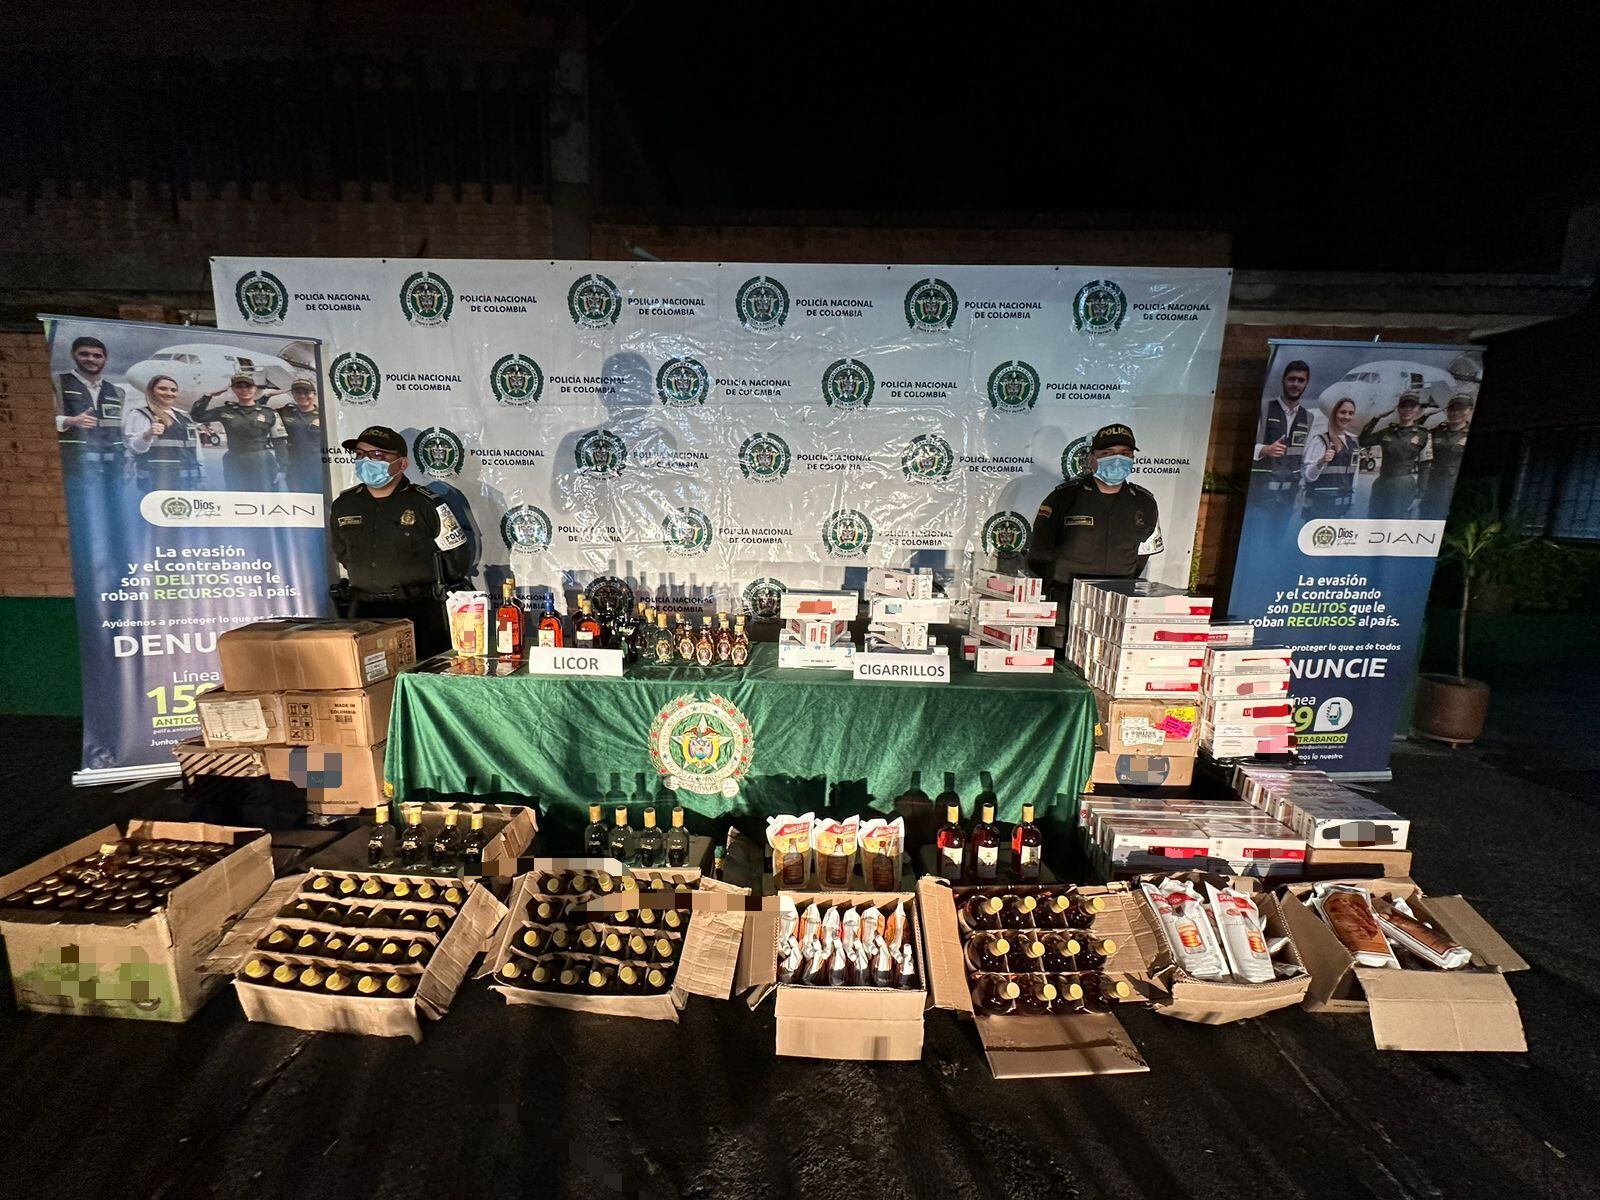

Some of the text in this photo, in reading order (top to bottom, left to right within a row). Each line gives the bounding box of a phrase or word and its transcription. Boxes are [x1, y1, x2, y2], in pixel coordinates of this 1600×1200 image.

[418, 374, 462, 382] NACIONAL
[716, 378, 747, 386] POLICÍA
[881, 380, 912, 388] POLICÍA
[194, 500, 214, 510] Dios
[234, 504, 315, 515] DIAN
[1338, 528, 1353, 538] Dios
[1369, 532, 1435, 544] DIAN
[156, 546, 245, 557] La evasión
[128, 558, 272, 574] y el contrabando
[122, 572, 280, 587] son DELITOS que le
[1298, 574, 1367, 586] La evasión
[101, 585, 301, 602] roban RECURSOS al país.
[1276, 588, 1381, 602] y el contrabando
[1267, 602, 1385, 616] son DELITOS que le
[102, 618, 156, 628] Ayúdenos
[169, 616, 217, 627] proteger
[219, 615, 228, 623] lo
[232, 617, 250, 625] que
[1250, 616, 1400, 629] roban RECURSOS al país.
[114, 632, 217, 658] DENU
[1292, 644, 1327, 652] proteger
[553, 656, 598, 670] LICOR
[1292, 658, 1388, 679] NUNCIE
[173, 671, 220, 683] Línea
[860, 664, 944, 678] CIGARRILLOS
[147, 683, 216, 714] 15
